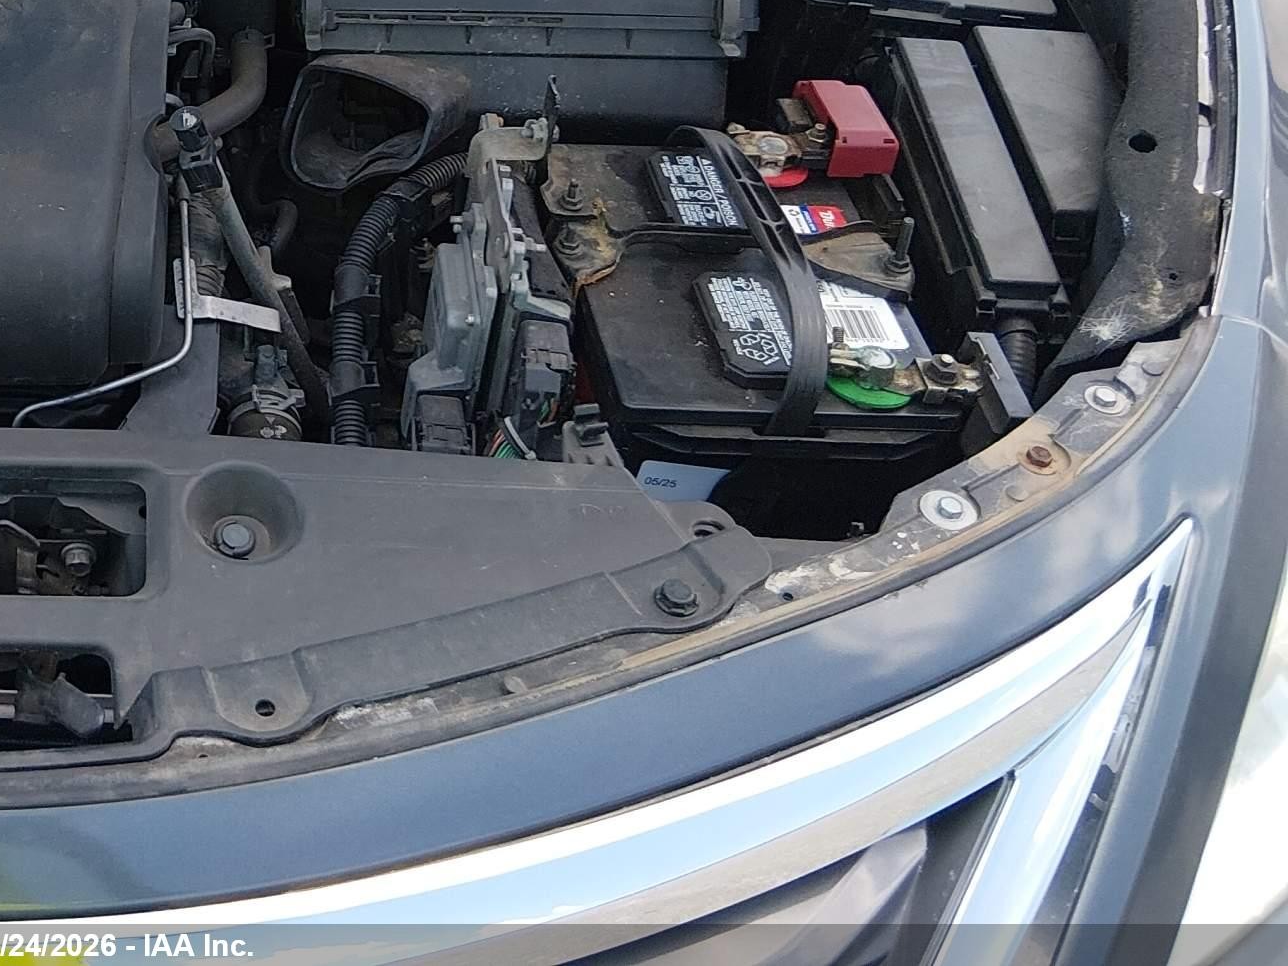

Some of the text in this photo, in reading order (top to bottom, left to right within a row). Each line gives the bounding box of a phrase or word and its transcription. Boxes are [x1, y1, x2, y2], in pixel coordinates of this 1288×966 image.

[703, 165, 725, 194] DANGER
[717, 199, 739, 226] POISON
[643, 476, 677, 488] 05/25
